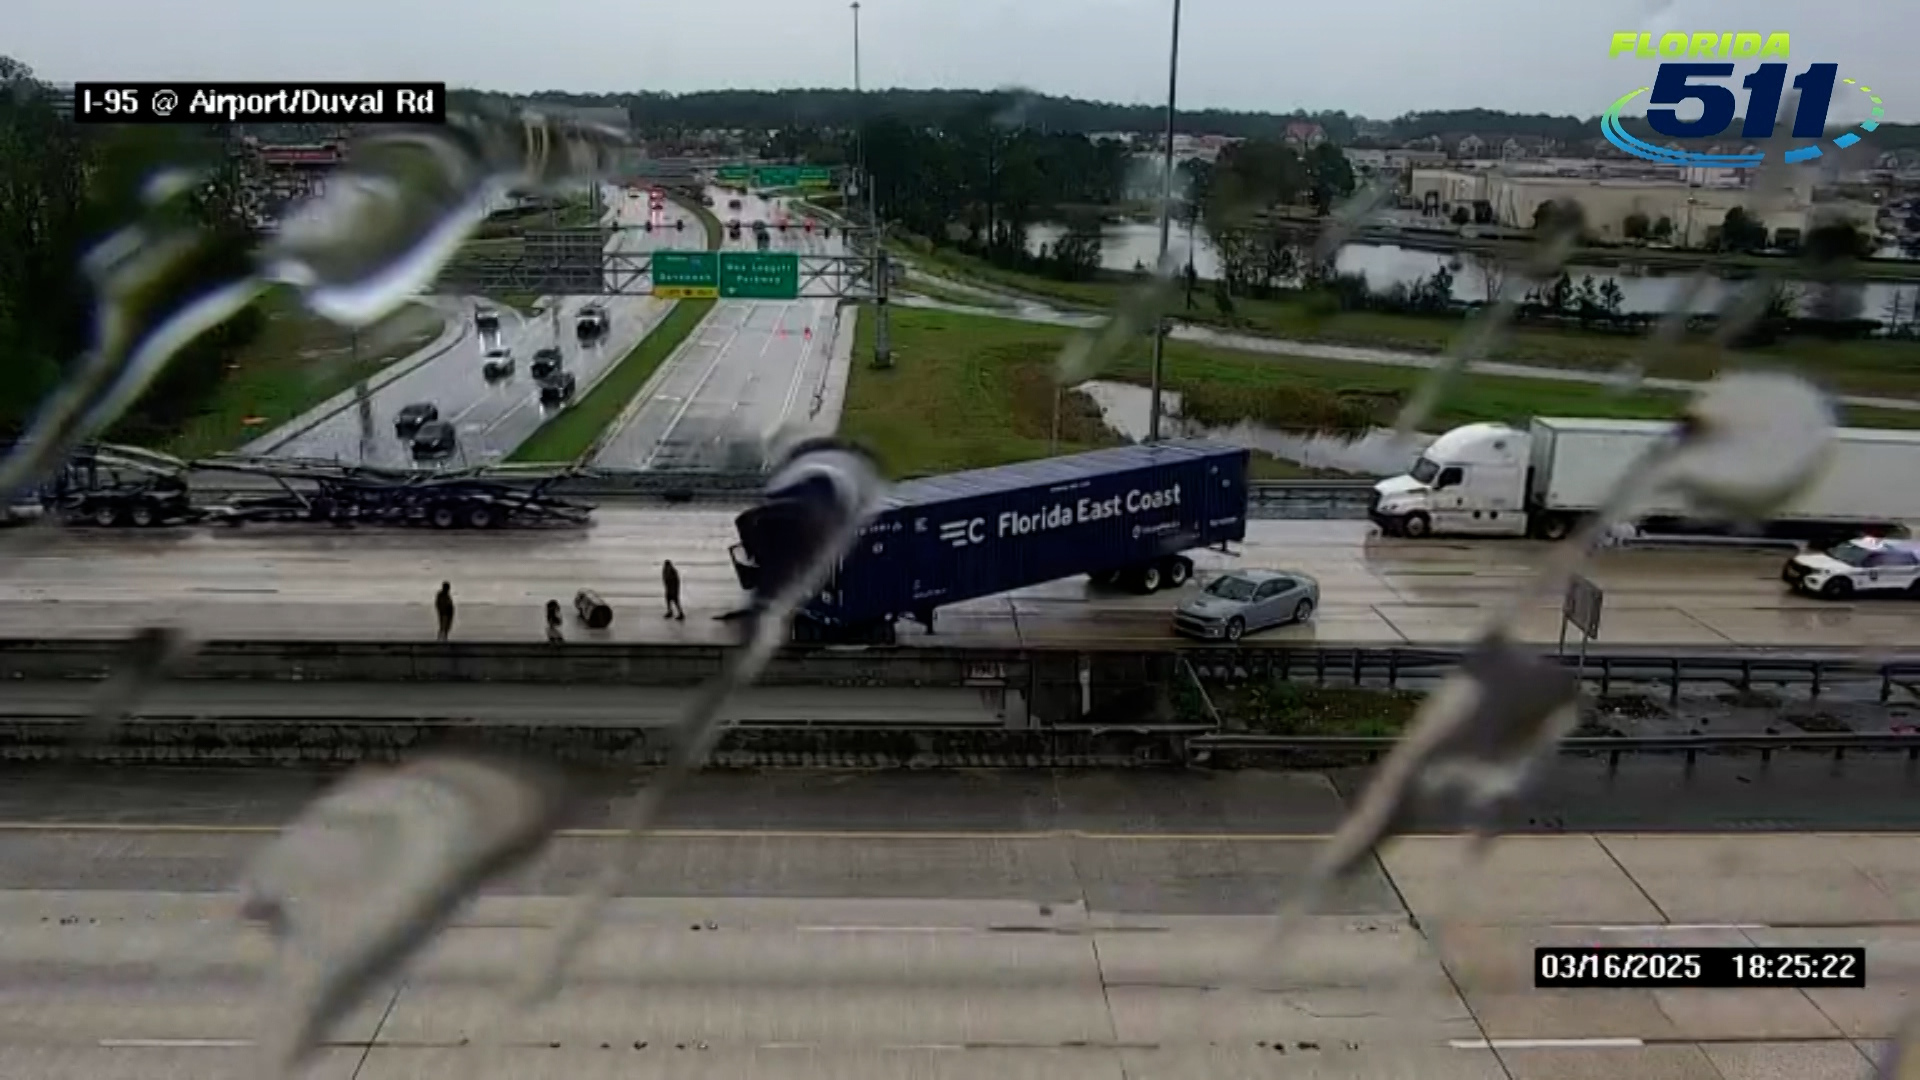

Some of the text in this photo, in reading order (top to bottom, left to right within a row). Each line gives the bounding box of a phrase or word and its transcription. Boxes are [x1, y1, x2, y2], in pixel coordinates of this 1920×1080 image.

[998, 483, 1182, 538] Florida East Coast
